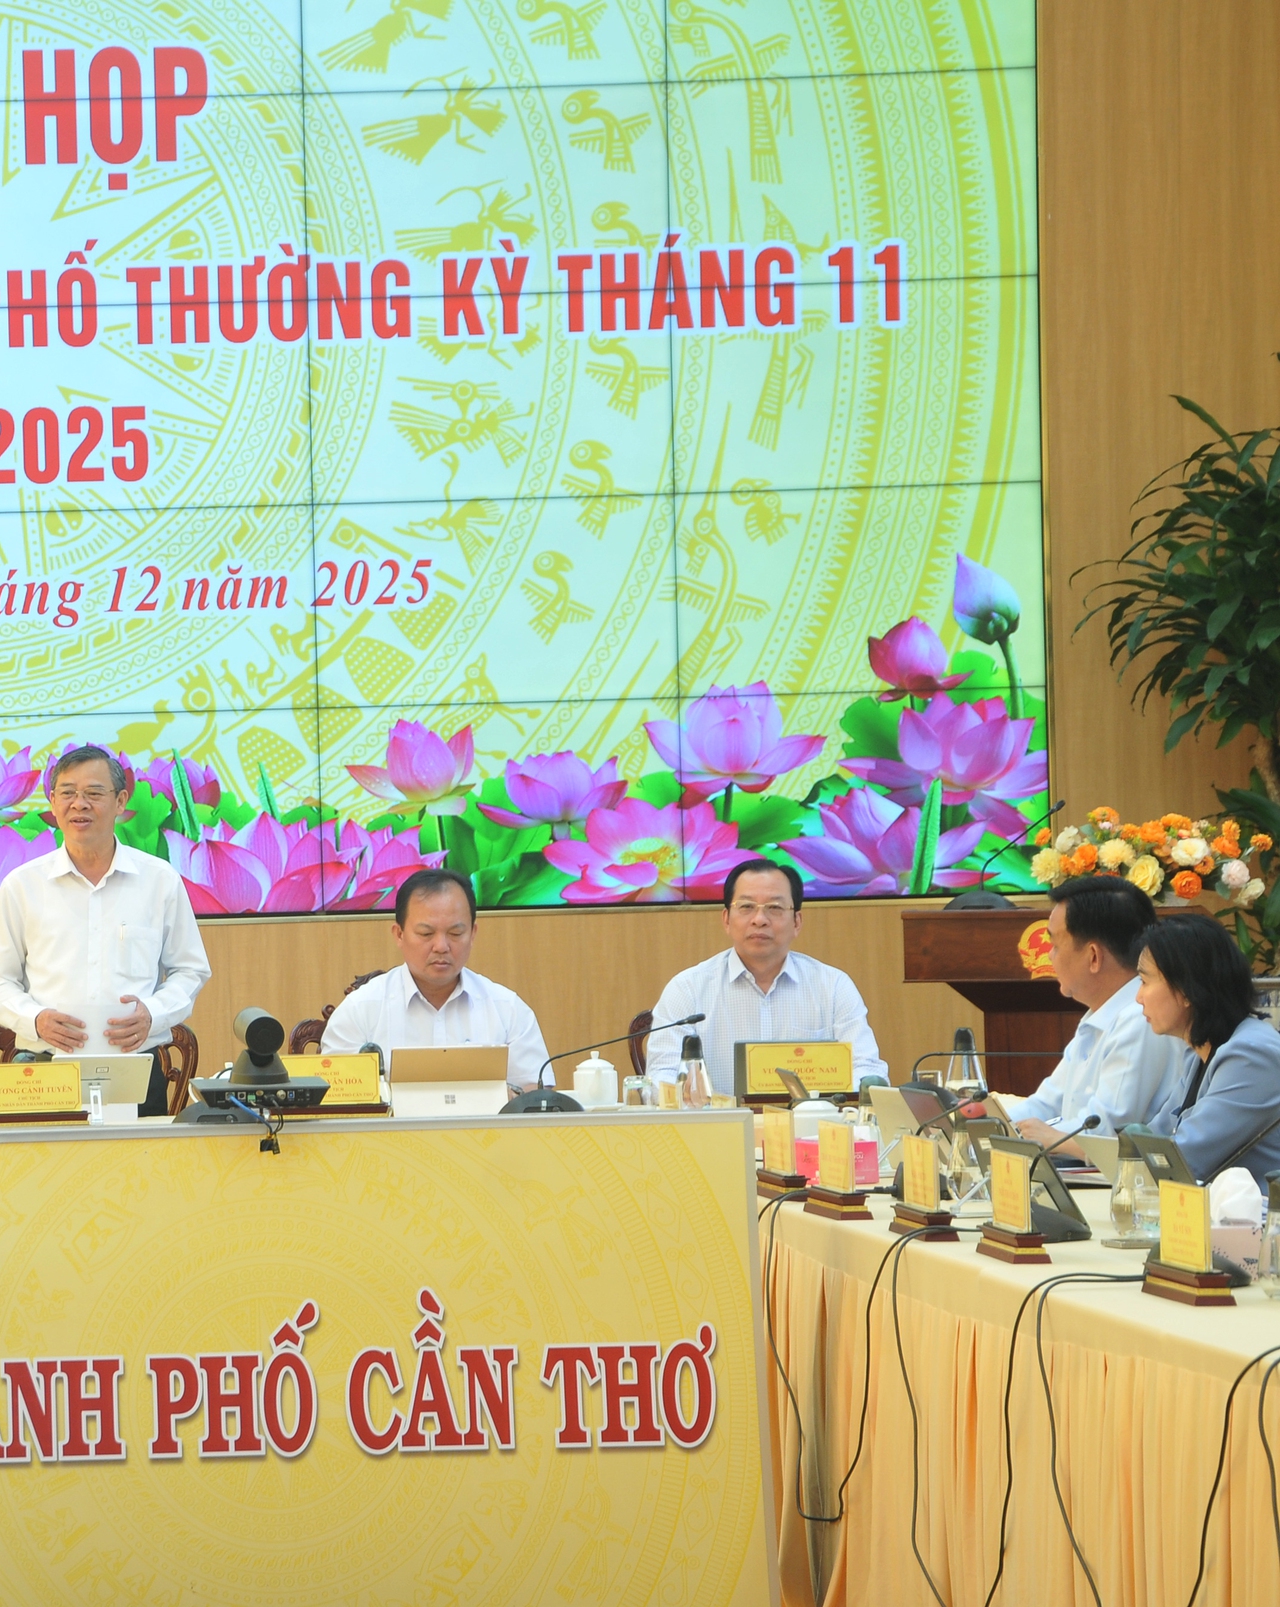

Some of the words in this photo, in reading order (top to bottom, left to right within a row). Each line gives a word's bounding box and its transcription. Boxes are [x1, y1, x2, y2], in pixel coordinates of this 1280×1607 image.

[23, 47, 207, 190] HỌP
[126, 243, 412, 346] THƯỜNG
[443, 239, 531, 337] KỲ
[557, 233, 795, 333] THÁNG
[827, 245, 902, 324] 11
[108, 565, 161, 613] 12
[182, 561, 288, 612] năm
[314, 558, 433, 607] 2025
[327, 1077, 343, 1085] VĂN
[345, 1076, 363, 1085] HÒA
[819, 1066, 838, 1074] NAM
[146, 1299, 317, 1459] PHỐ
[347, 1287, 518, 1453] CẦN
[541, 1322, 716, 1450] THƠ
